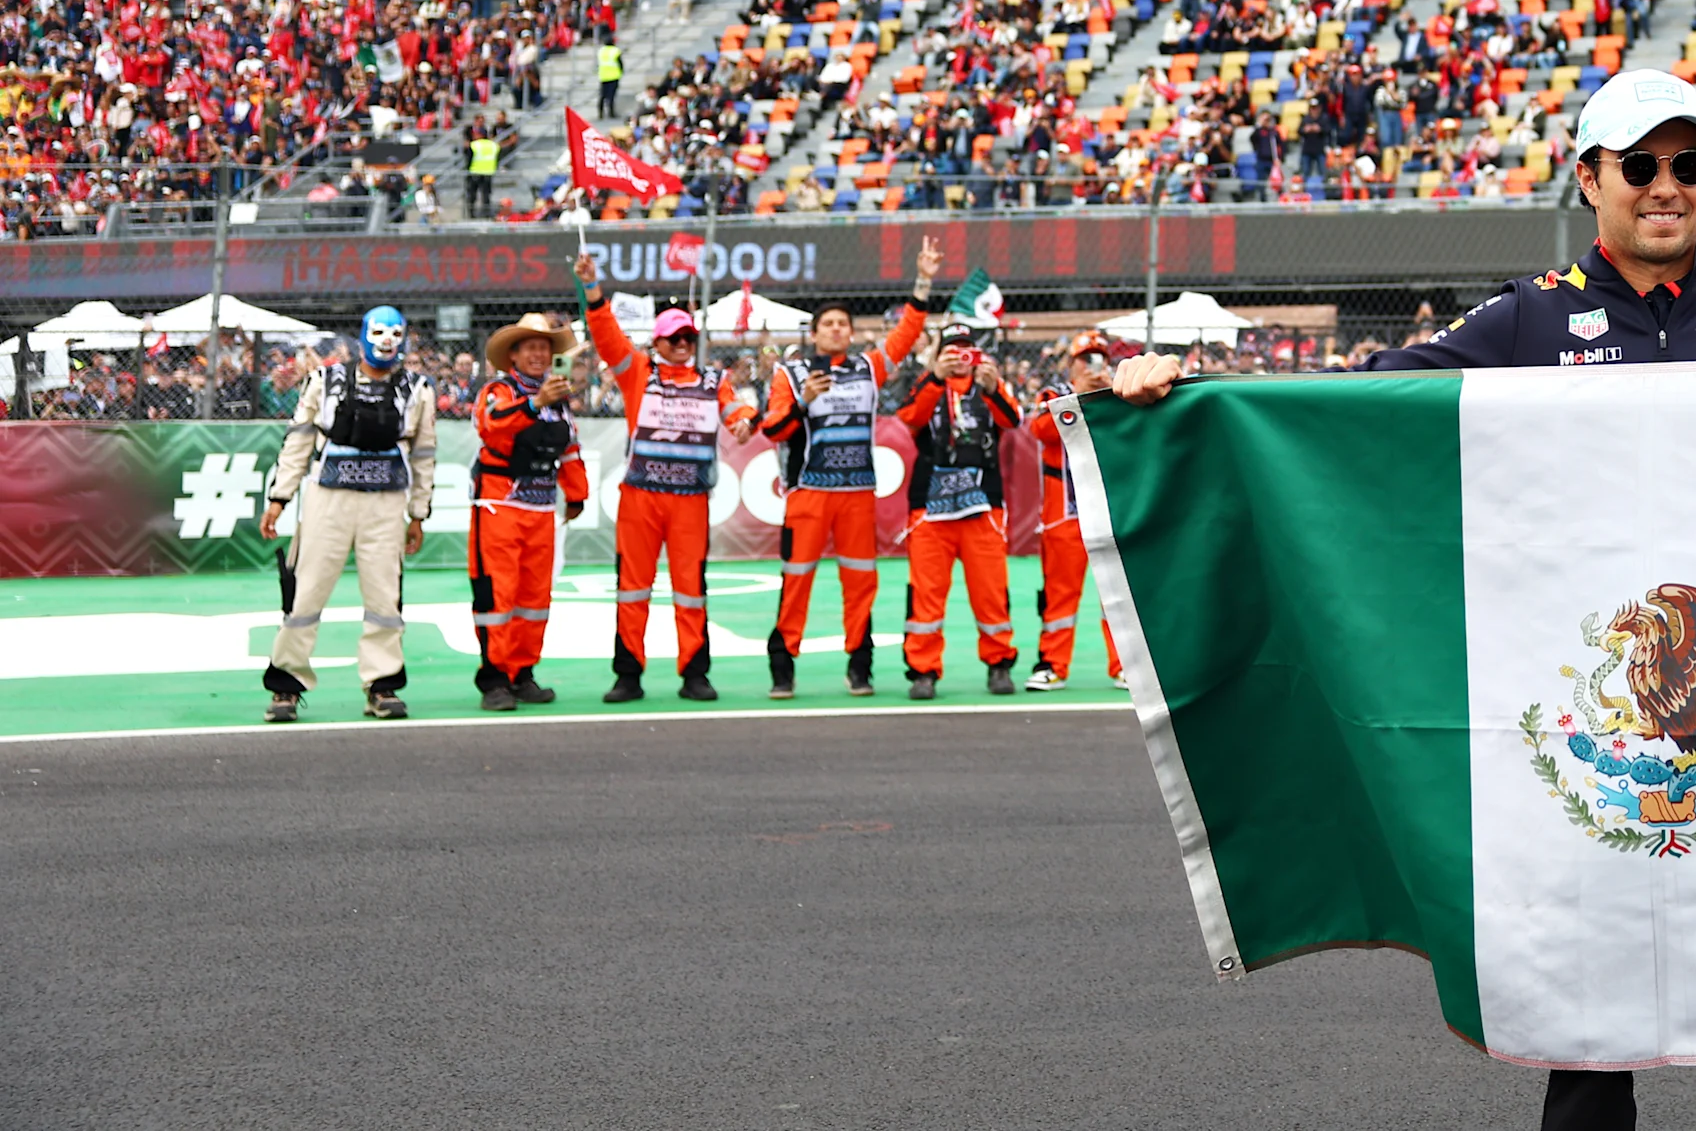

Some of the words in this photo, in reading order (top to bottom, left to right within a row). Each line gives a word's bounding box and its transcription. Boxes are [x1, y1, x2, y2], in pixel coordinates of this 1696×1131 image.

[1571, 310, 1606, 324] TAG
[1570, 321, 1608, 337] HEUER
[1559, 348, 1605, 366] Mobil
[337, 460, 391, 471] COURSE
[337, 471, 391, 484] ACCESS
